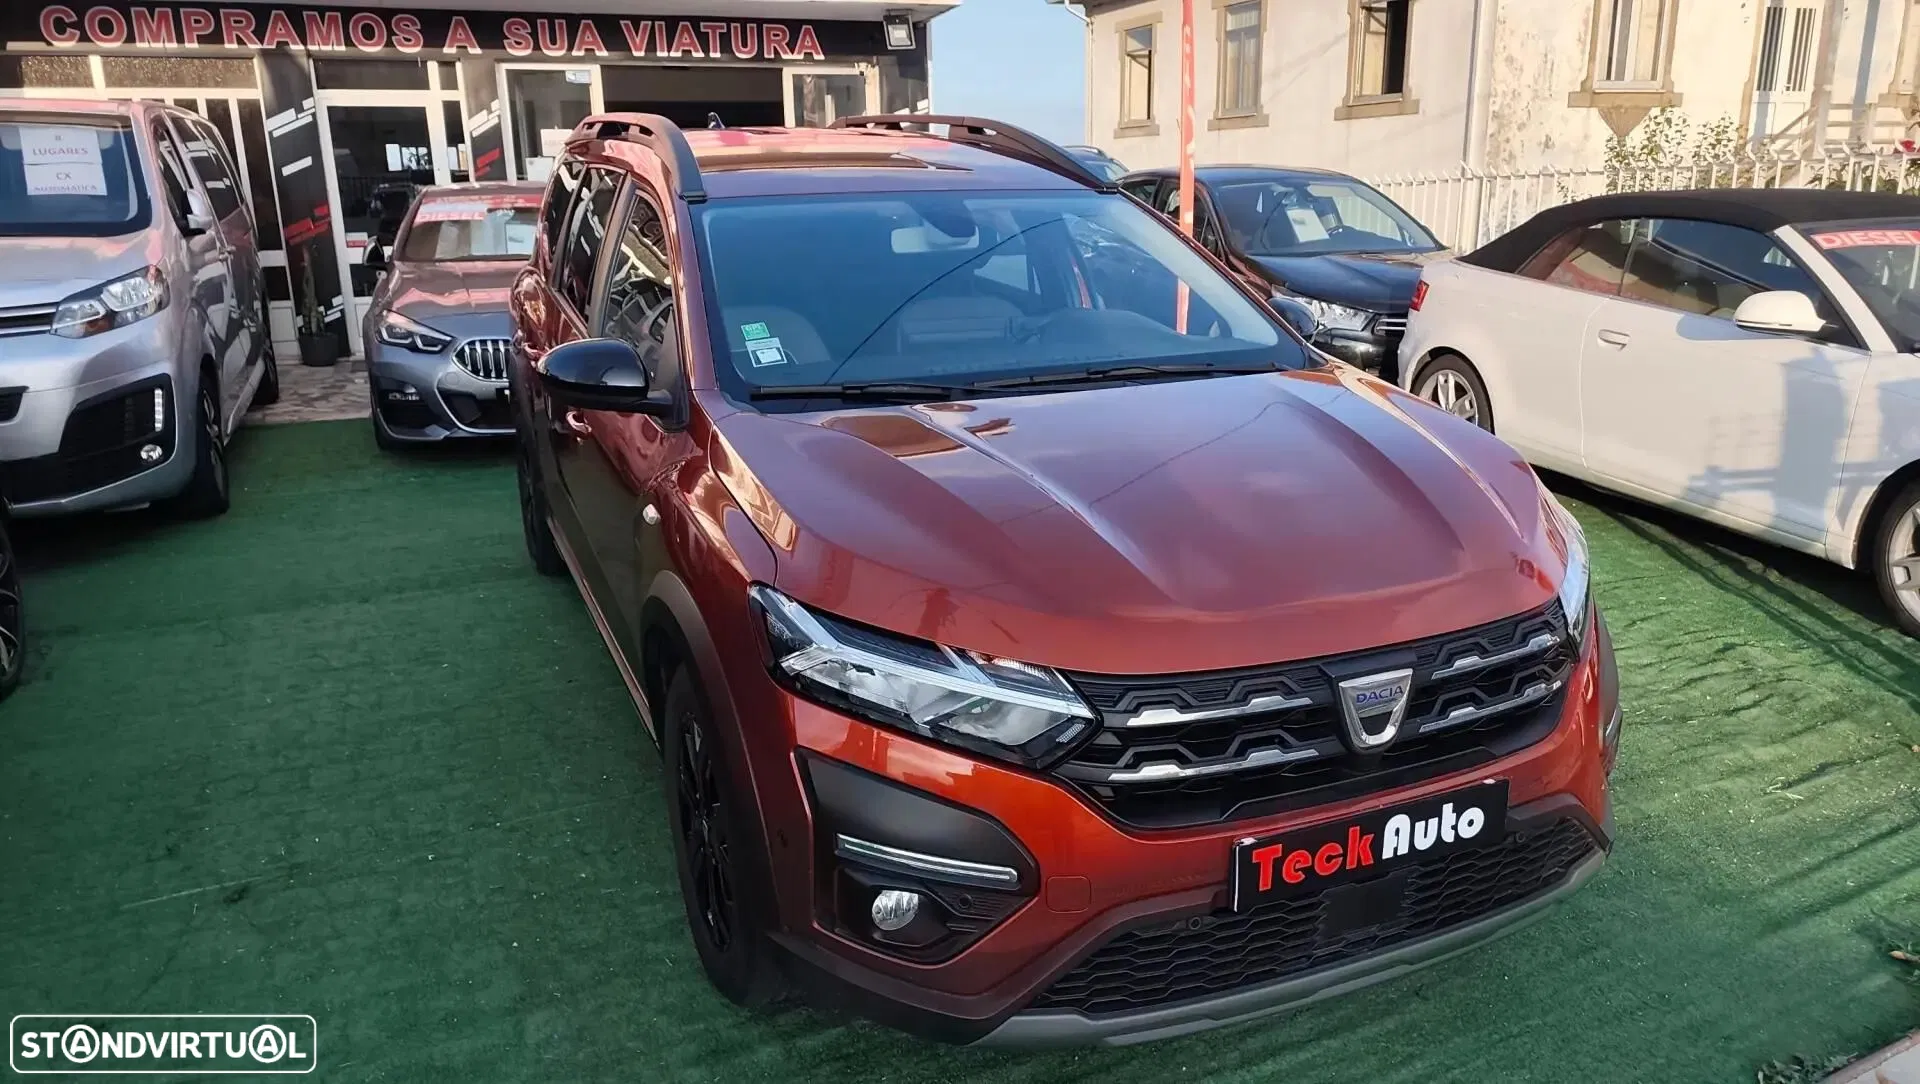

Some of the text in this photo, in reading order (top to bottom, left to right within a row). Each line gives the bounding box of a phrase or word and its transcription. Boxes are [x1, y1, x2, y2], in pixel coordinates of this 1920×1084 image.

[39, 6, 826, 60] COMPRAMOS A SUA VIATURA
[32, 147, 89, 156] LUGARES
[1356, 685, 1404, 703] DACIA
[1252, 802, 1485, 892] Teck Auto
